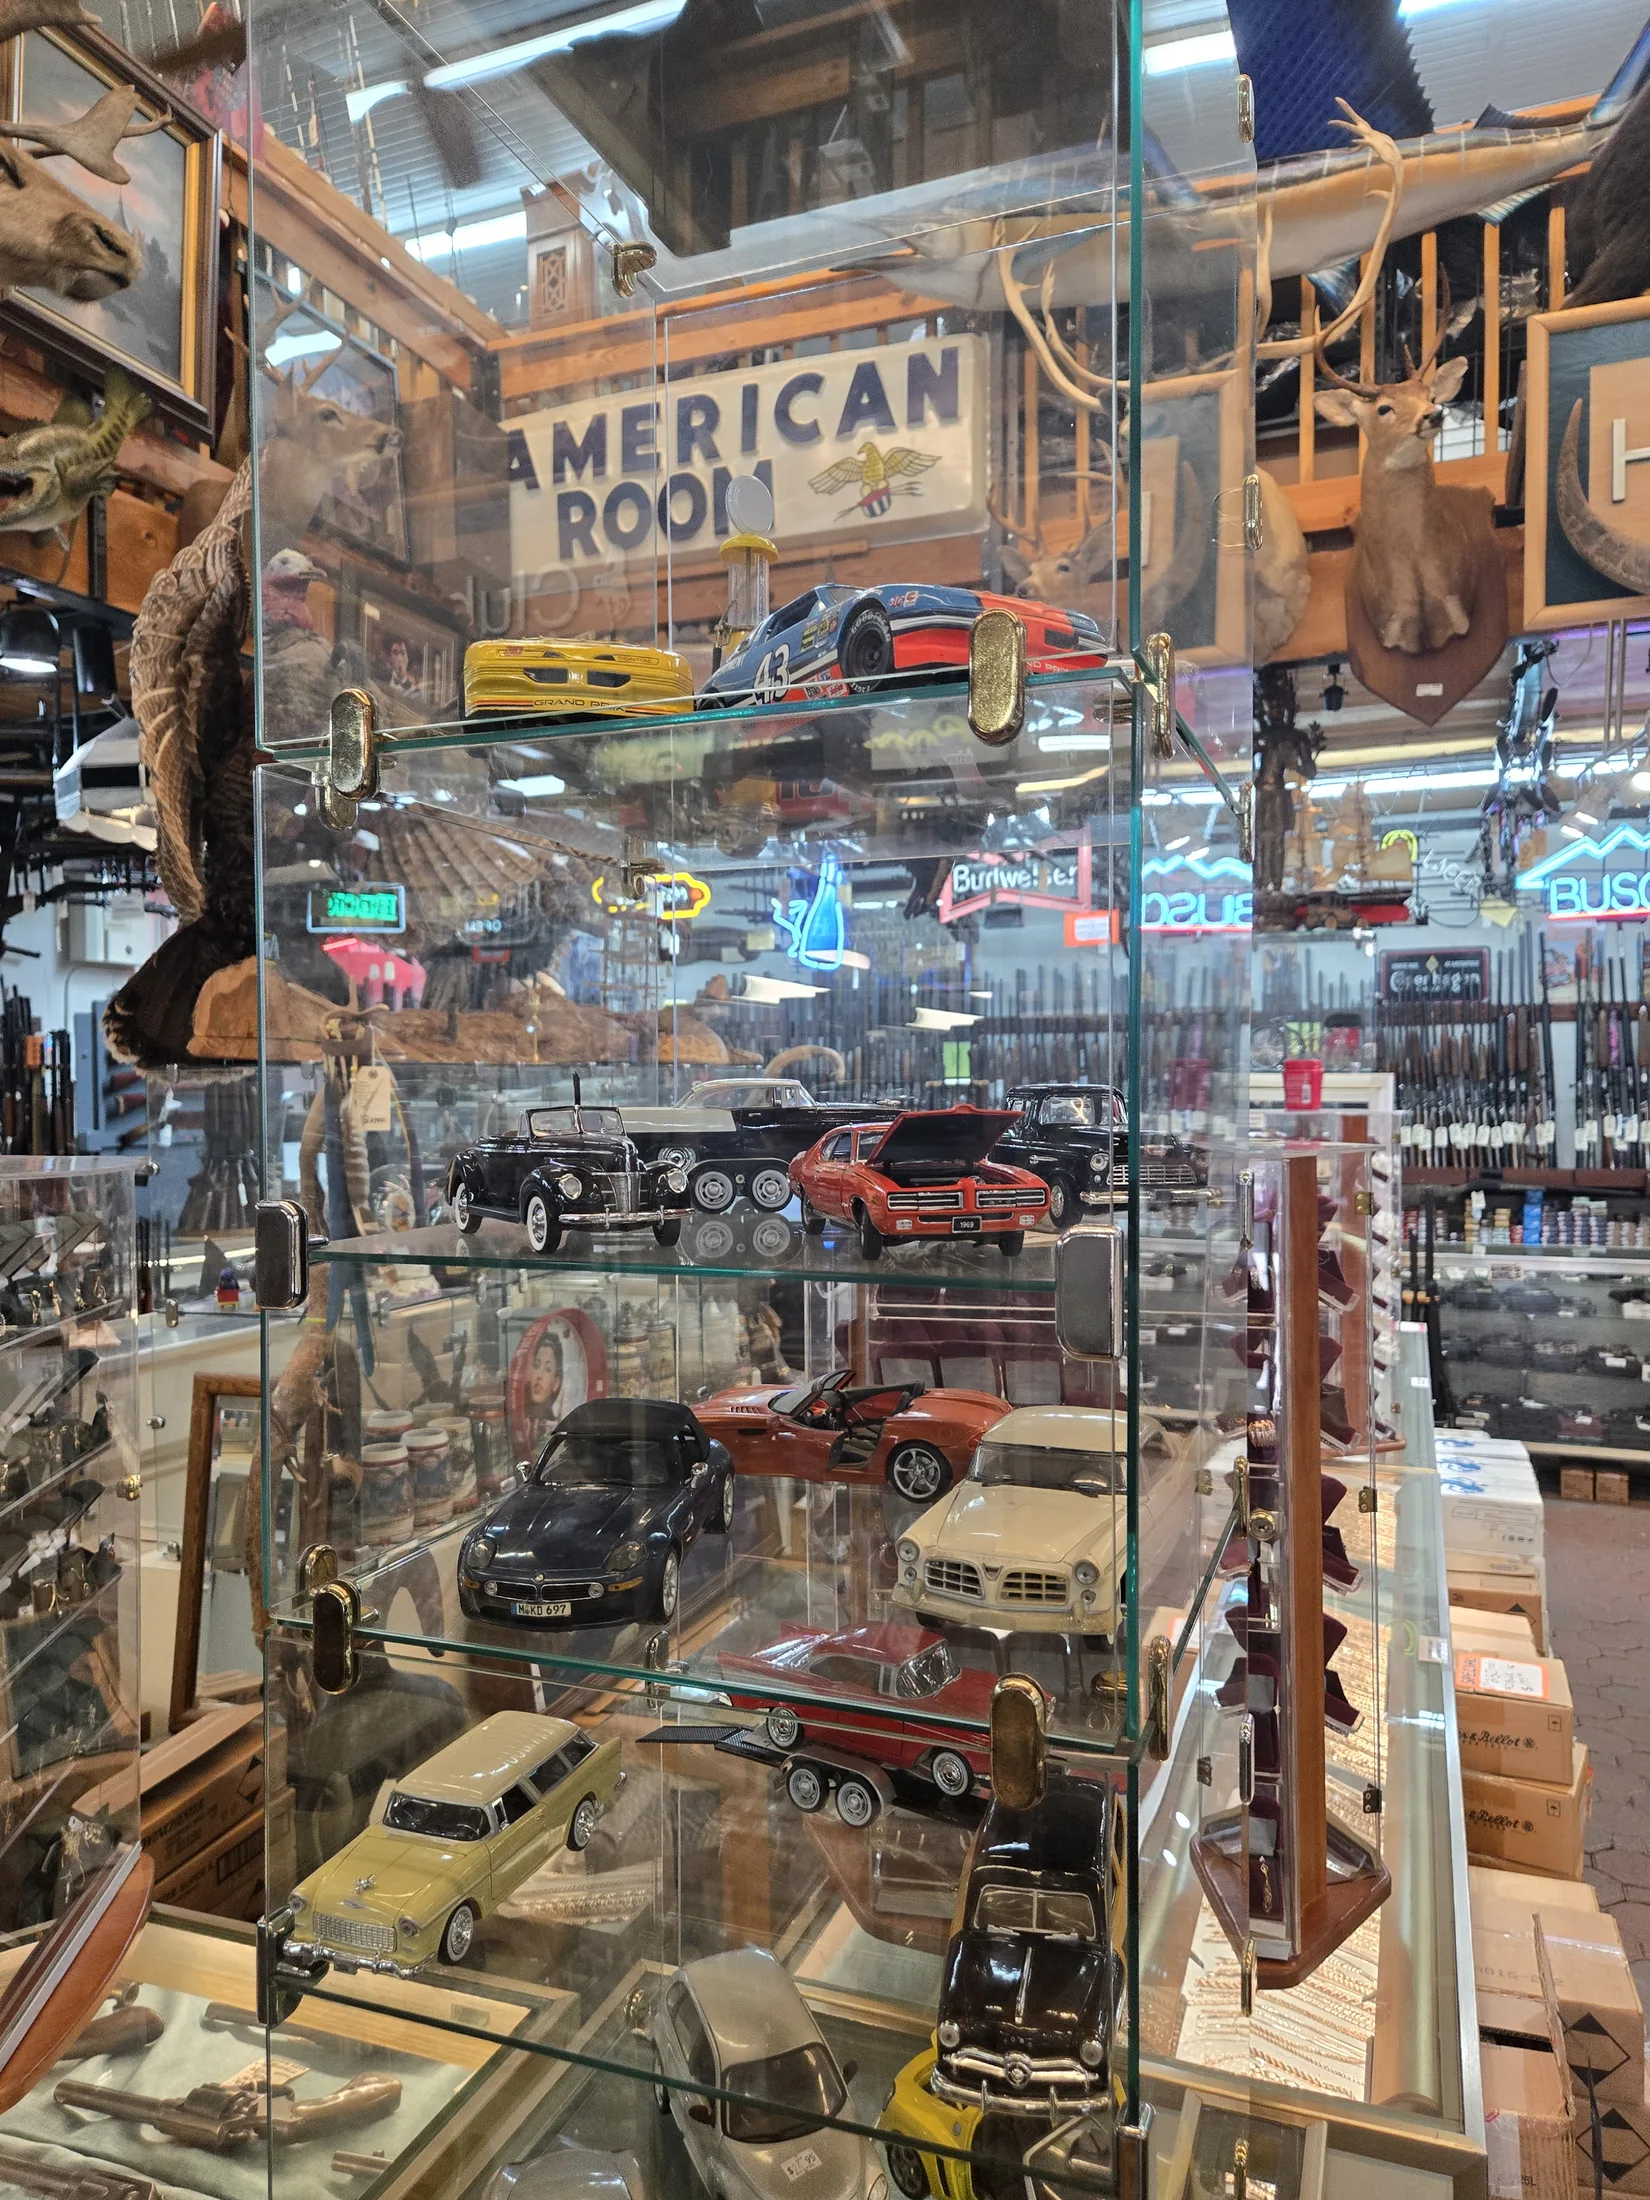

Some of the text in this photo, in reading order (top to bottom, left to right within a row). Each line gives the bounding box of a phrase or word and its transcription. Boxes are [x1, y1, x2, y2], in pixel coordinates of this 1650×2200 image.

[508, 346, 959, 490] AMERICAN
[617, 655, 654, 665] PONTIAC
[753, 643, 791, 704] 43
[533, 699, 586, 708] GRAND
[952, 864, 1078, 893] Budweier
[959, 1220, 975, 1229] 1969
[530, 1605, 543, 1616] KD
[546, 1604, 567, 1615] 697
[1477, 1730, 1520, 1747] Bellot
[1477, 1809, 1519, 1829] Bellot
